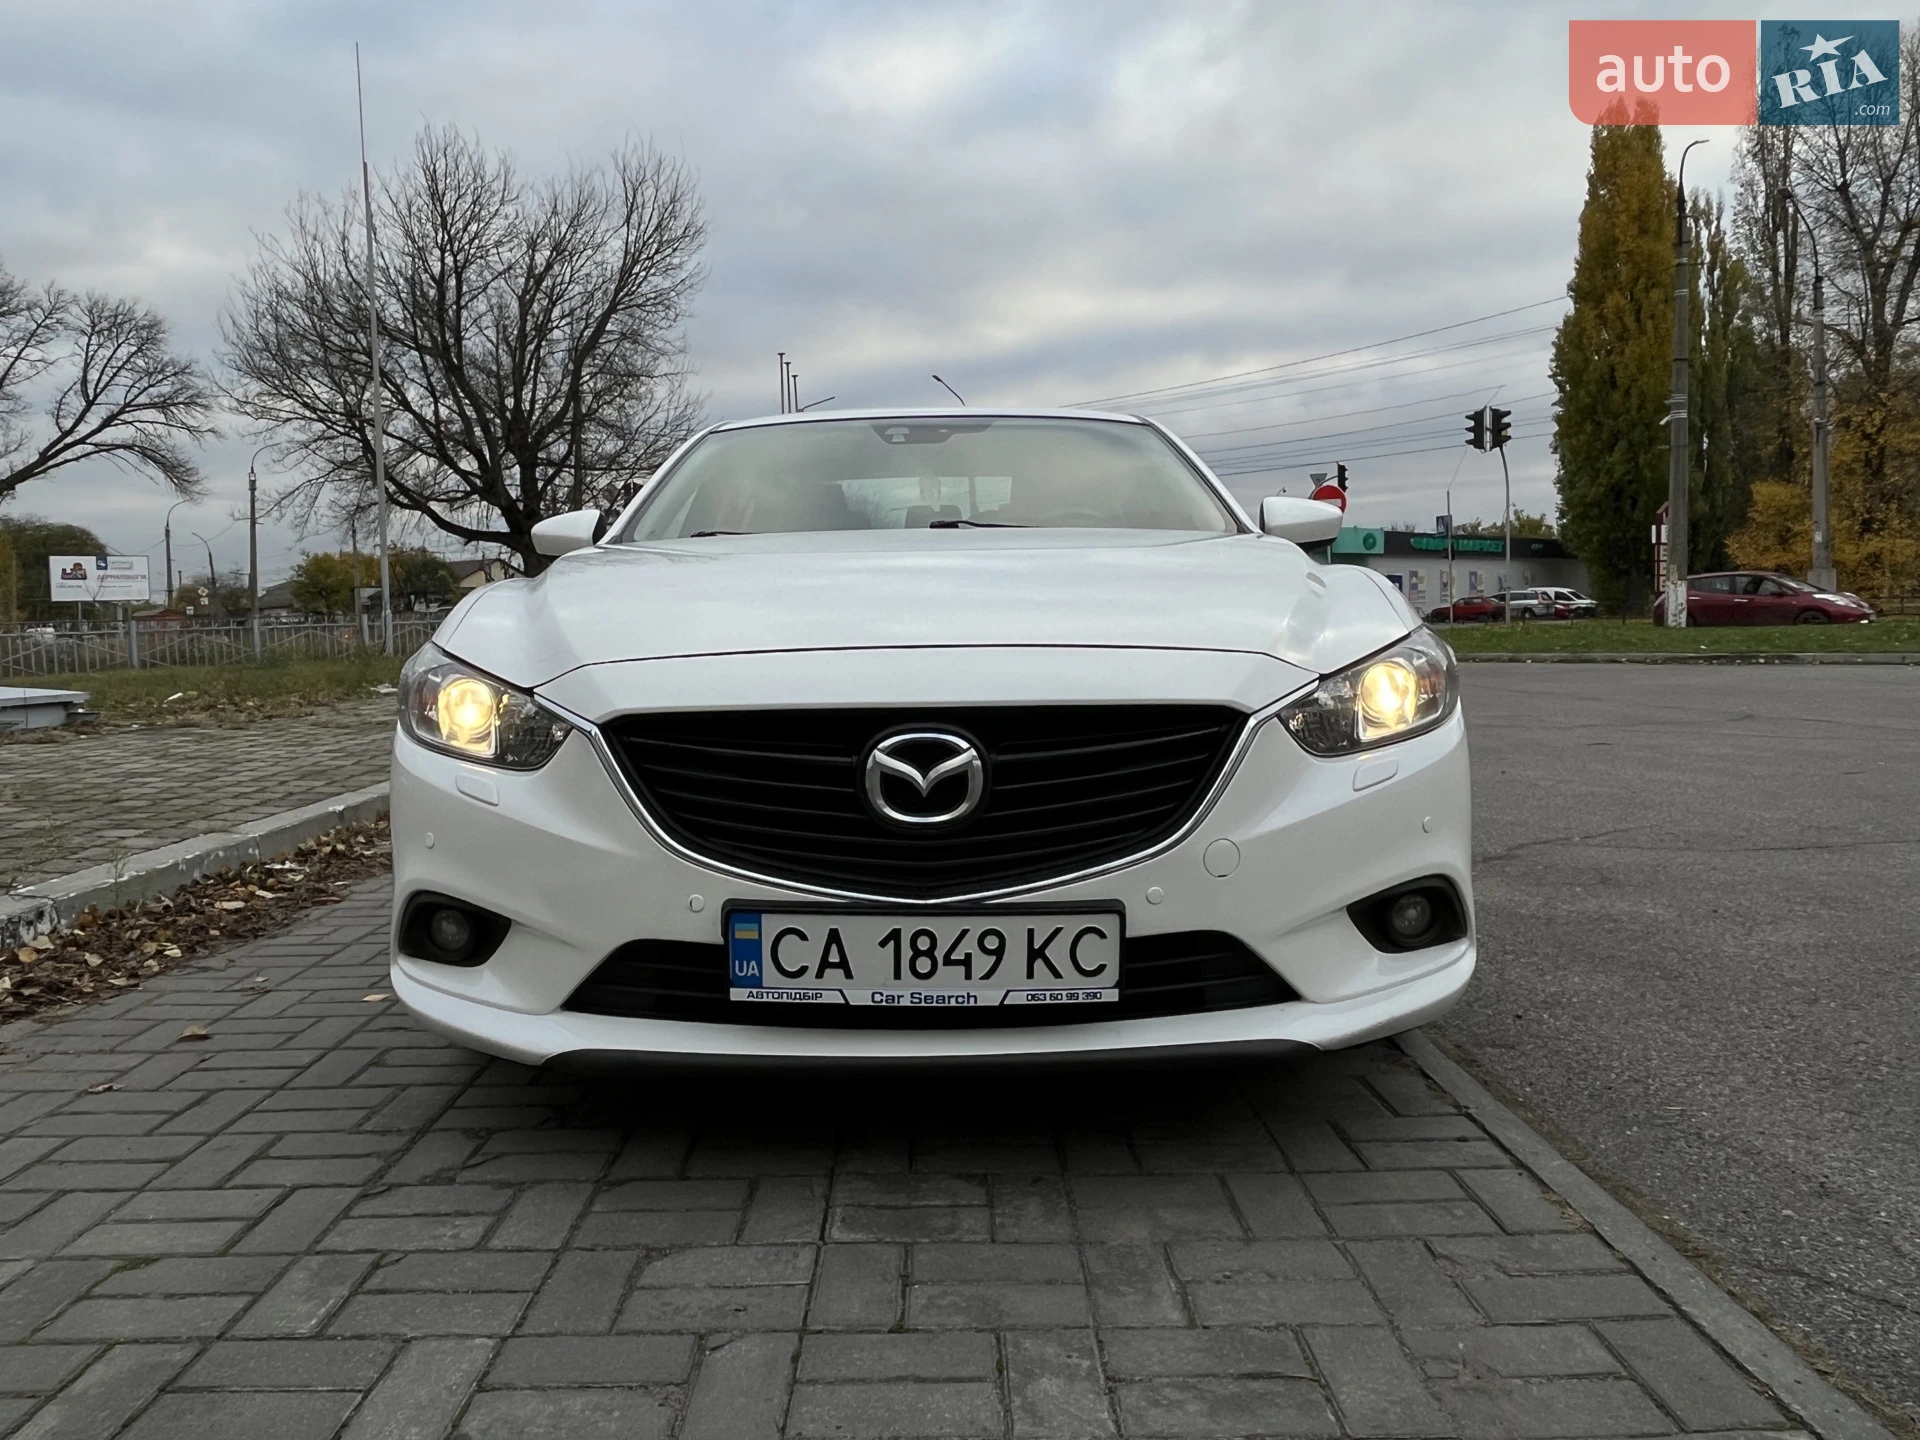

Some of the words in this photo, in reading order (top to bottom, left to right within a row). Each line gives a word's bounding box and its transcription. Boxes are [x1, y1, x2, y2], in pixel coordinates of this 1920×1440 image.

[769, 926, 855, 981] CA
[877, 927, 1007, 981] 1849
[1025, 925, 1108, 980] KC
[735, 960, 759, 977] UA
[746, 990, 823, 1002] АВТОПІДБІР
[870, 991, 905, 1005] Car
[909, 991, 978, 1005] Search
